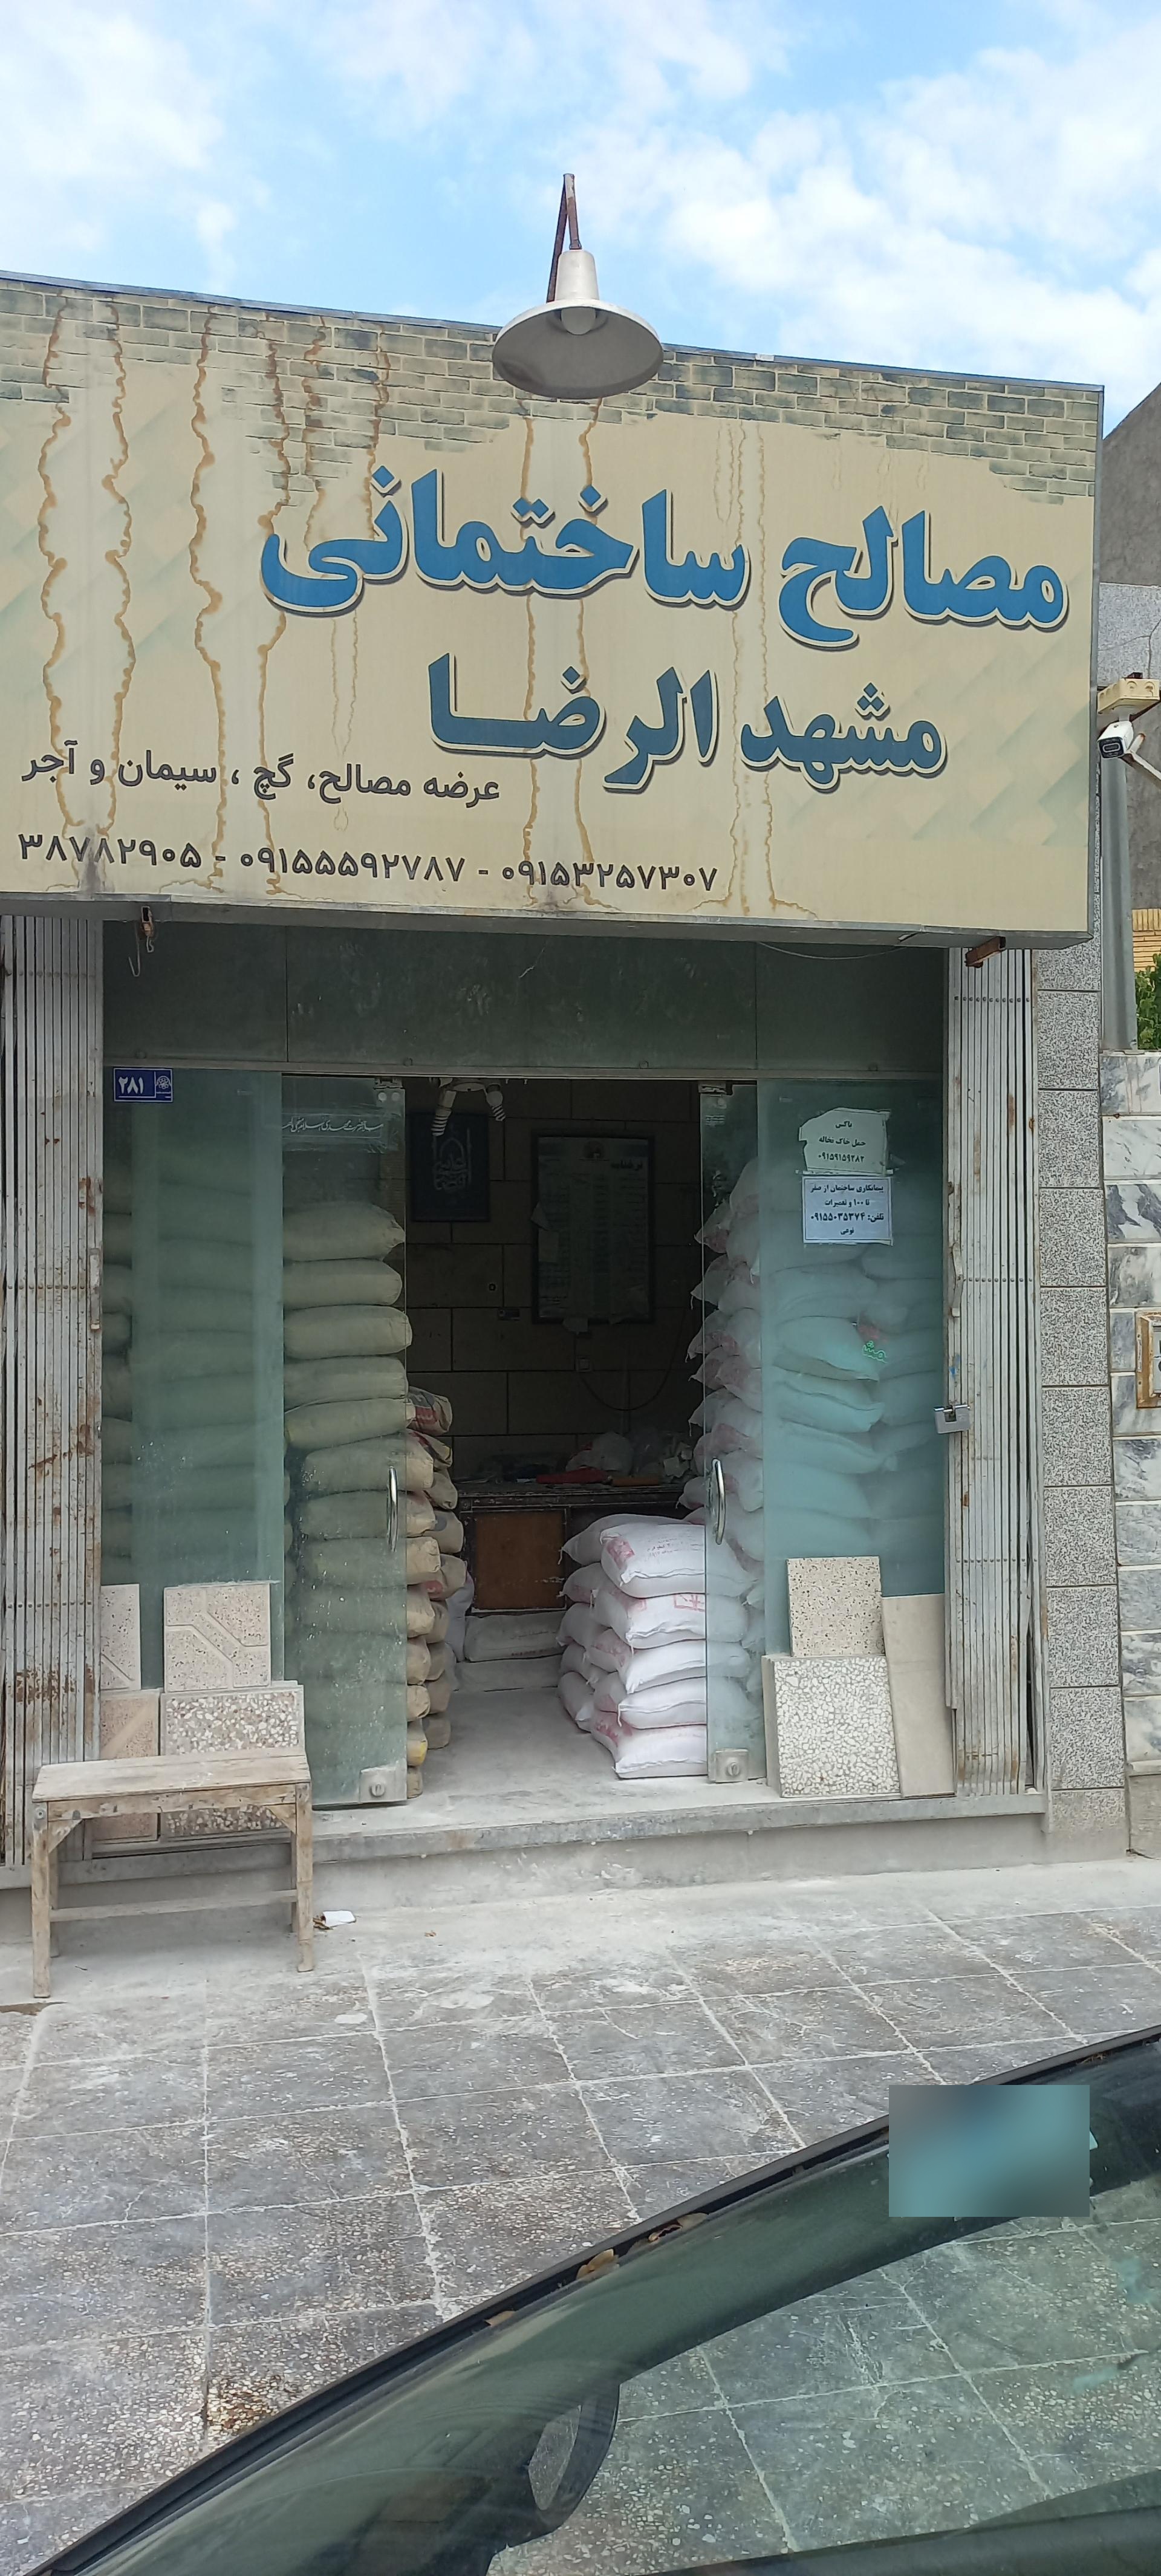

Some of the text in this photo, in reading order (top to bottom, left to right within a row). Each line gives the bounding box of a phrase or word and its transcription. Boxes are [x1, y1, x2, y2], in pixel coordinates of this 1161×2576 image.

[261, 466, 1068, 646] مصالح ساختمانی
[741, 683, 946, 791] مشهد
[22, 740, 78, 783] آجر
[90, 759, 105, 785] و
[119, 750, 216, 790] سیمان
[253, 753, 294, 800] گچ
[308, 763, 411, 804] مصالح،
[423, 772, 500, 808] عرضه
[18, 834, 201, 868] ۳۸۷۸۲۹۰۵
[240, 847, 465, 882] ۰۹۱۵۵۵۹۲۷۸۷
[502, 860, 717, 891] ۰۹۱۵۳۲۵۷۳۰۷
[119, 1076, 143, 1093] ۲۸۱
[835, 1120, 853, 1130] باکس
[851, 1139, 866, 1147] حمل
[810, 1185, 822, 1193] صفر
[824, 1199, 847, 1208] تعمیرات
[856, 1185, 883, 1193] پیمانکاری
[867, 1212, 884, 1222] تلفن:
